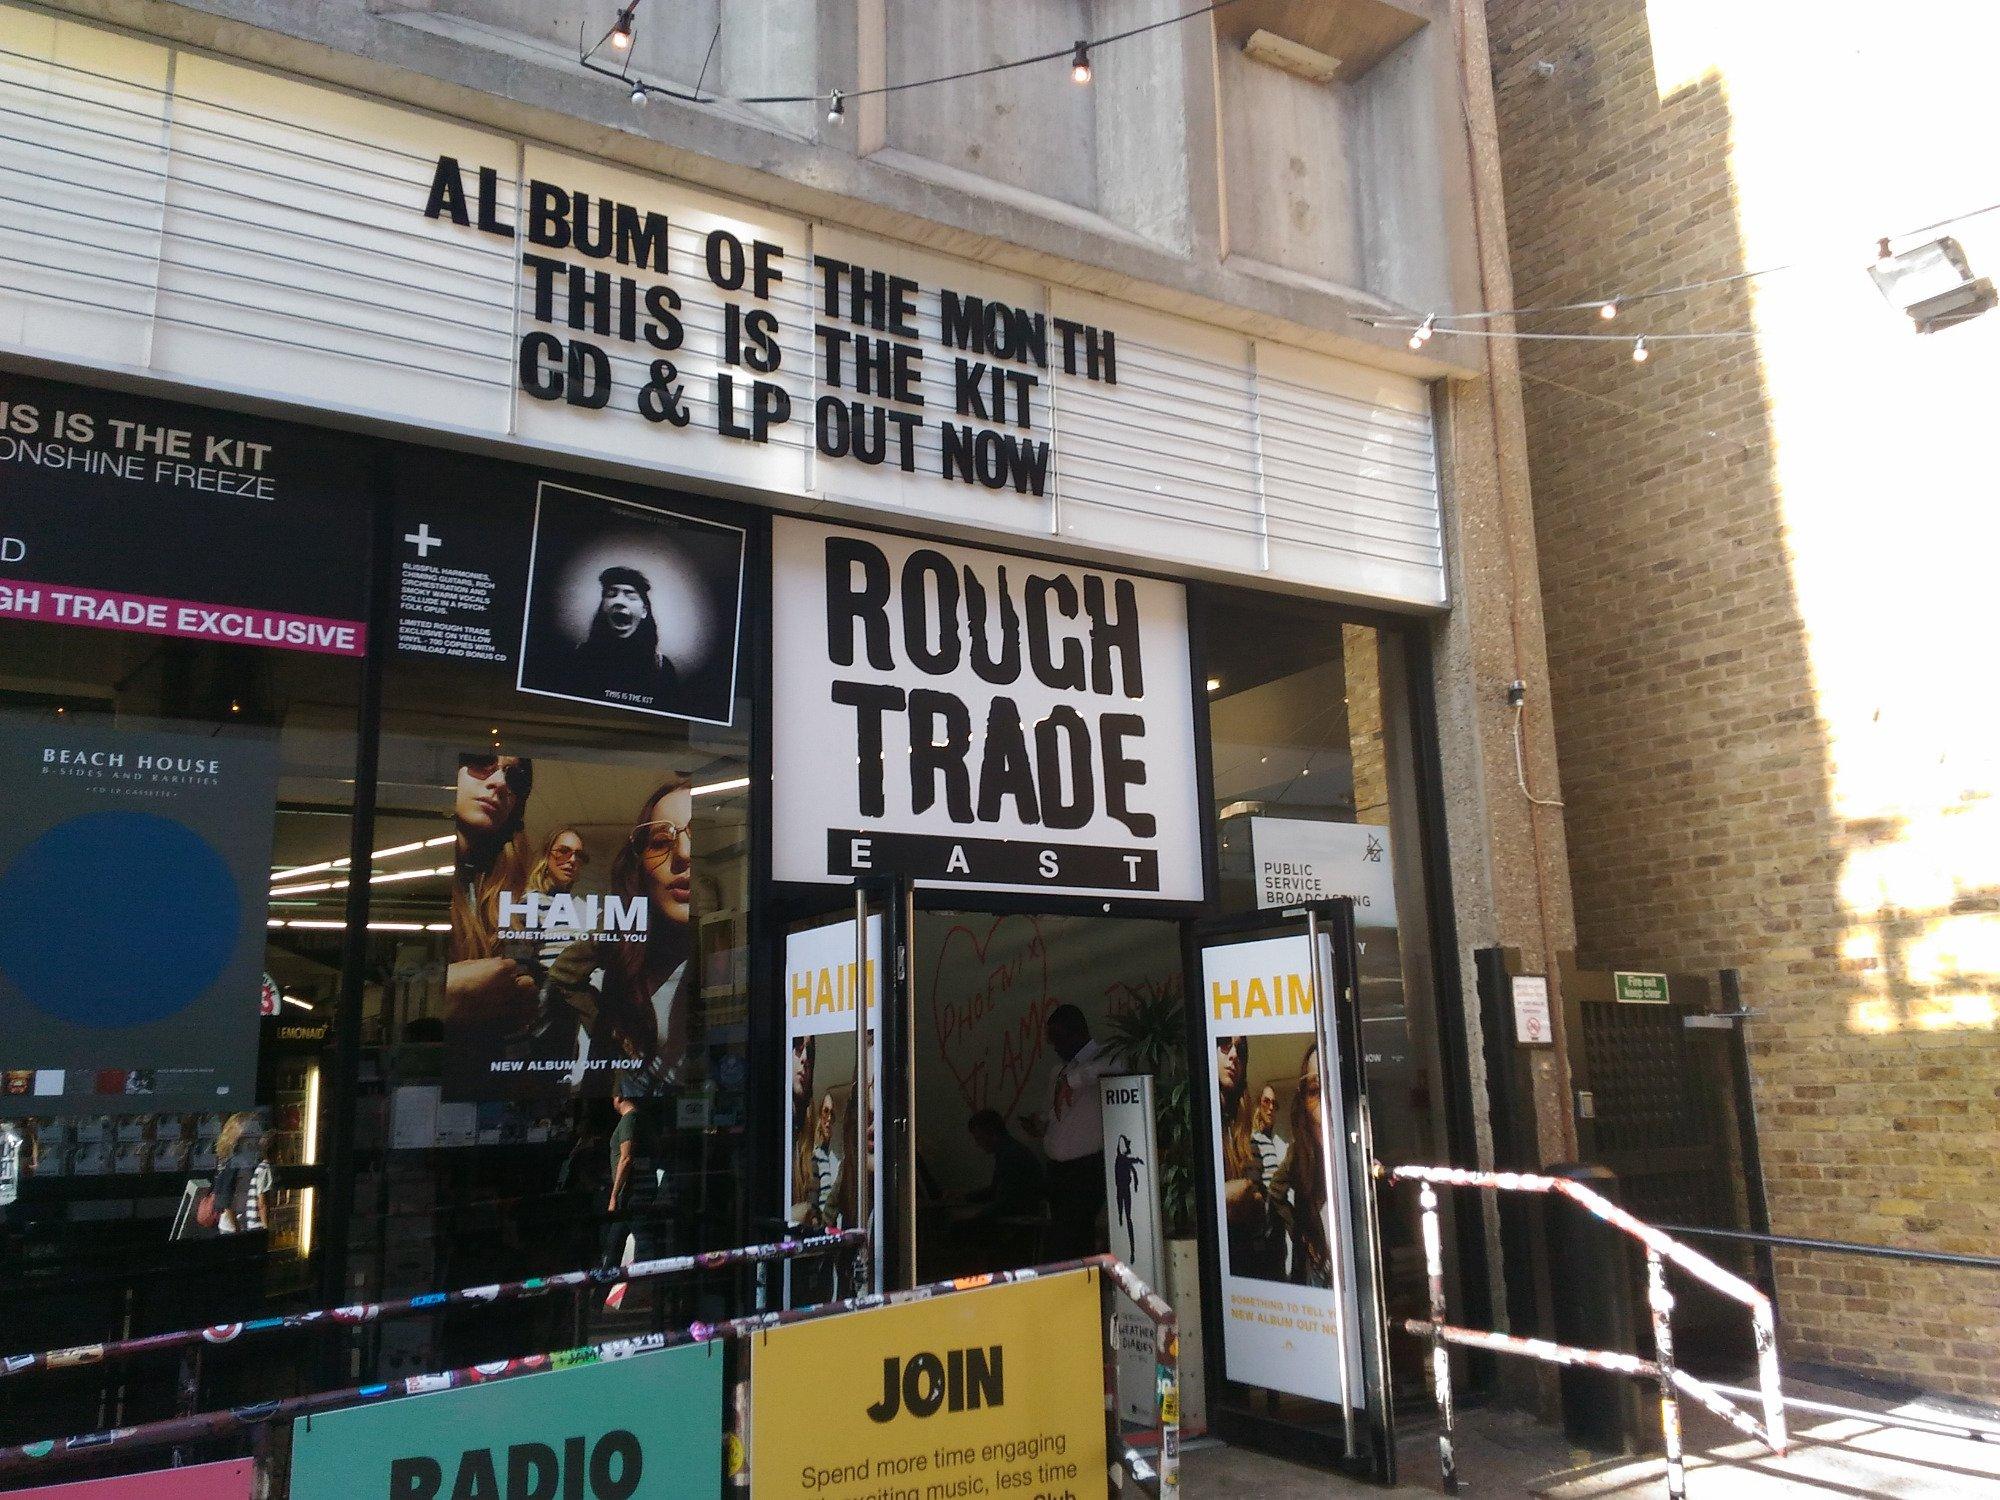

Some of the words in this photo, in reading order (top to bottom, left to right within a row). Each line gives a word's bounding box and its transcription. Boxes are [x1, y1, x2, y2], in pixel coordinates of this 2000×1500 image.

[424, 155, 668, 274] ALBUM
[705, 230, 784, 300] OF
[814, 255, 918, 339] THE
[941, 288, 1117, 386] MONTH
[522, 252, 684, 351] THIS
[724, 302, 782, 373] IS
[815, 323, 925, 406] THE
[955, 357, 1039, 430] KIT
[519, 331, 611, 409] CD
[637, 358, 690, 427] &
[717, 372, 791, 444] LP
[816, 395, 923, 472] OUT
[941, 420, 1050, 497] NOW
[53, 410, 95, 443] IS
[108, 418, 192, 459] THE
[204, 435, 273, 471] KIT
[154, 460, 276, 501] FREEZE
[400, 602, 423, 611] FOLK
[432, 591, 458, 601] WARM
[458, 594, 491, 605] VOCALS
[469, 588, 487, 596] AND
[50, 592, 168, 629] TRADE
[177, 607, 356, 650] EXCLUSIVE
[399, 619, 432, 629] LIMITED
[433, 623, 463, 632] ROUGH
[464, 626, 491, 636] TRADE
[825, 536, 1145, 700] ROUGH
[399, 626, 444, 638] EXCLUSIVE
[444, 632, 458, 640] ON
[459, 634, 492, 644] YELLOW
[444, 640, 474, 650] COPIES
[398, 642, 446, 655] DOWNLOAD
[447, 649, 465, 657] AND
[465, 651, 494, 660] BONUS
[494, 654, 507, 662] CD
[43, 748, 124, 768] BEACH
[137, 755, 219, 774] HOUSE
[831, 678, 1158, 839] TRADE
[112, 771, 142, 781] AND
[851, 838, 1142, 882] EAST
[1264, 862, 1313, 877] PUBLIC
[1265, 877, 1322, 892] SERVICE
[498, 890, 649, 932] HAIM
[497, 930, 571, 942] SOMETHING
[574, 932, 589, 941] TO
[592, 932, 620, 942] TELL
[623, 933, 647, 943] YOU
[791, 959, 875, 1018] HAIM
[1212, 973, 1315, 1021] HAIM
[490, 1060, 524, 1072] NEW
[527, 1060, 577, 1072] ALBUM
[584, 1059, 607, 1071] OUT
[611, 1059, 644, 1070] NOW
[1105, 1088, 1140, 1106] RIDE
[1230, 1294, 1283, 1312] SOMETHING
[1287, 1303, 1299, 1314] TO
[1302, 1304, 1324, 1318] TELL
[1230, 1308, 1254, 1321] NEW
[1257, 1313, 1293, 1329] ALBUM
[1297, 1319, 1317, 1332] OUT
[867, 1345, 1004, 1424] JOIN
[390, 1429, 643, 1500] RADIO
[801, 1458, 870, 1490] Spend
[876, 1454, 928, 1478] more
[933, 1446, 976, 1469] time
[981, 1432, 1067, 1464] engaging
[926, 1474, 990, 1500] music,
[995, 1469, 1034, 1491] less
[1037, 1460, 1079, 1485] time
